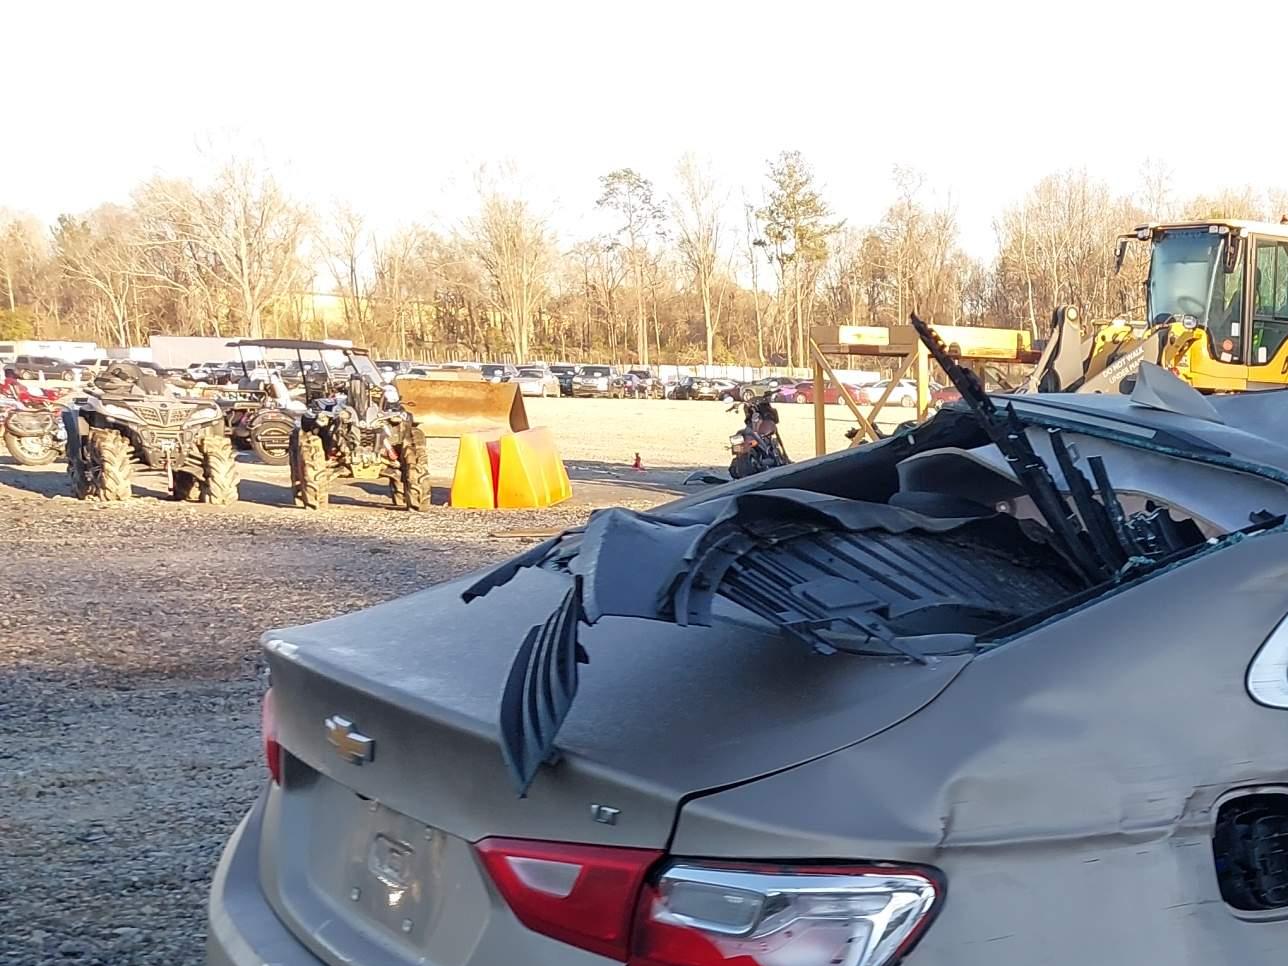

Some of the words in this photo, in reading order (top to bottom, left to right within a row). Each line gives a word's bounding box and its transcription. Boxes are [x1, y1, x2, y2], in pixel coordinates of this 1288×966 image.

[1103, 367, 1113, 378] DO
[1112, 358, 1126, 372] NOT
[1125, 346, 1144, 362] WALK
[591, 804, 621, 825] LT
